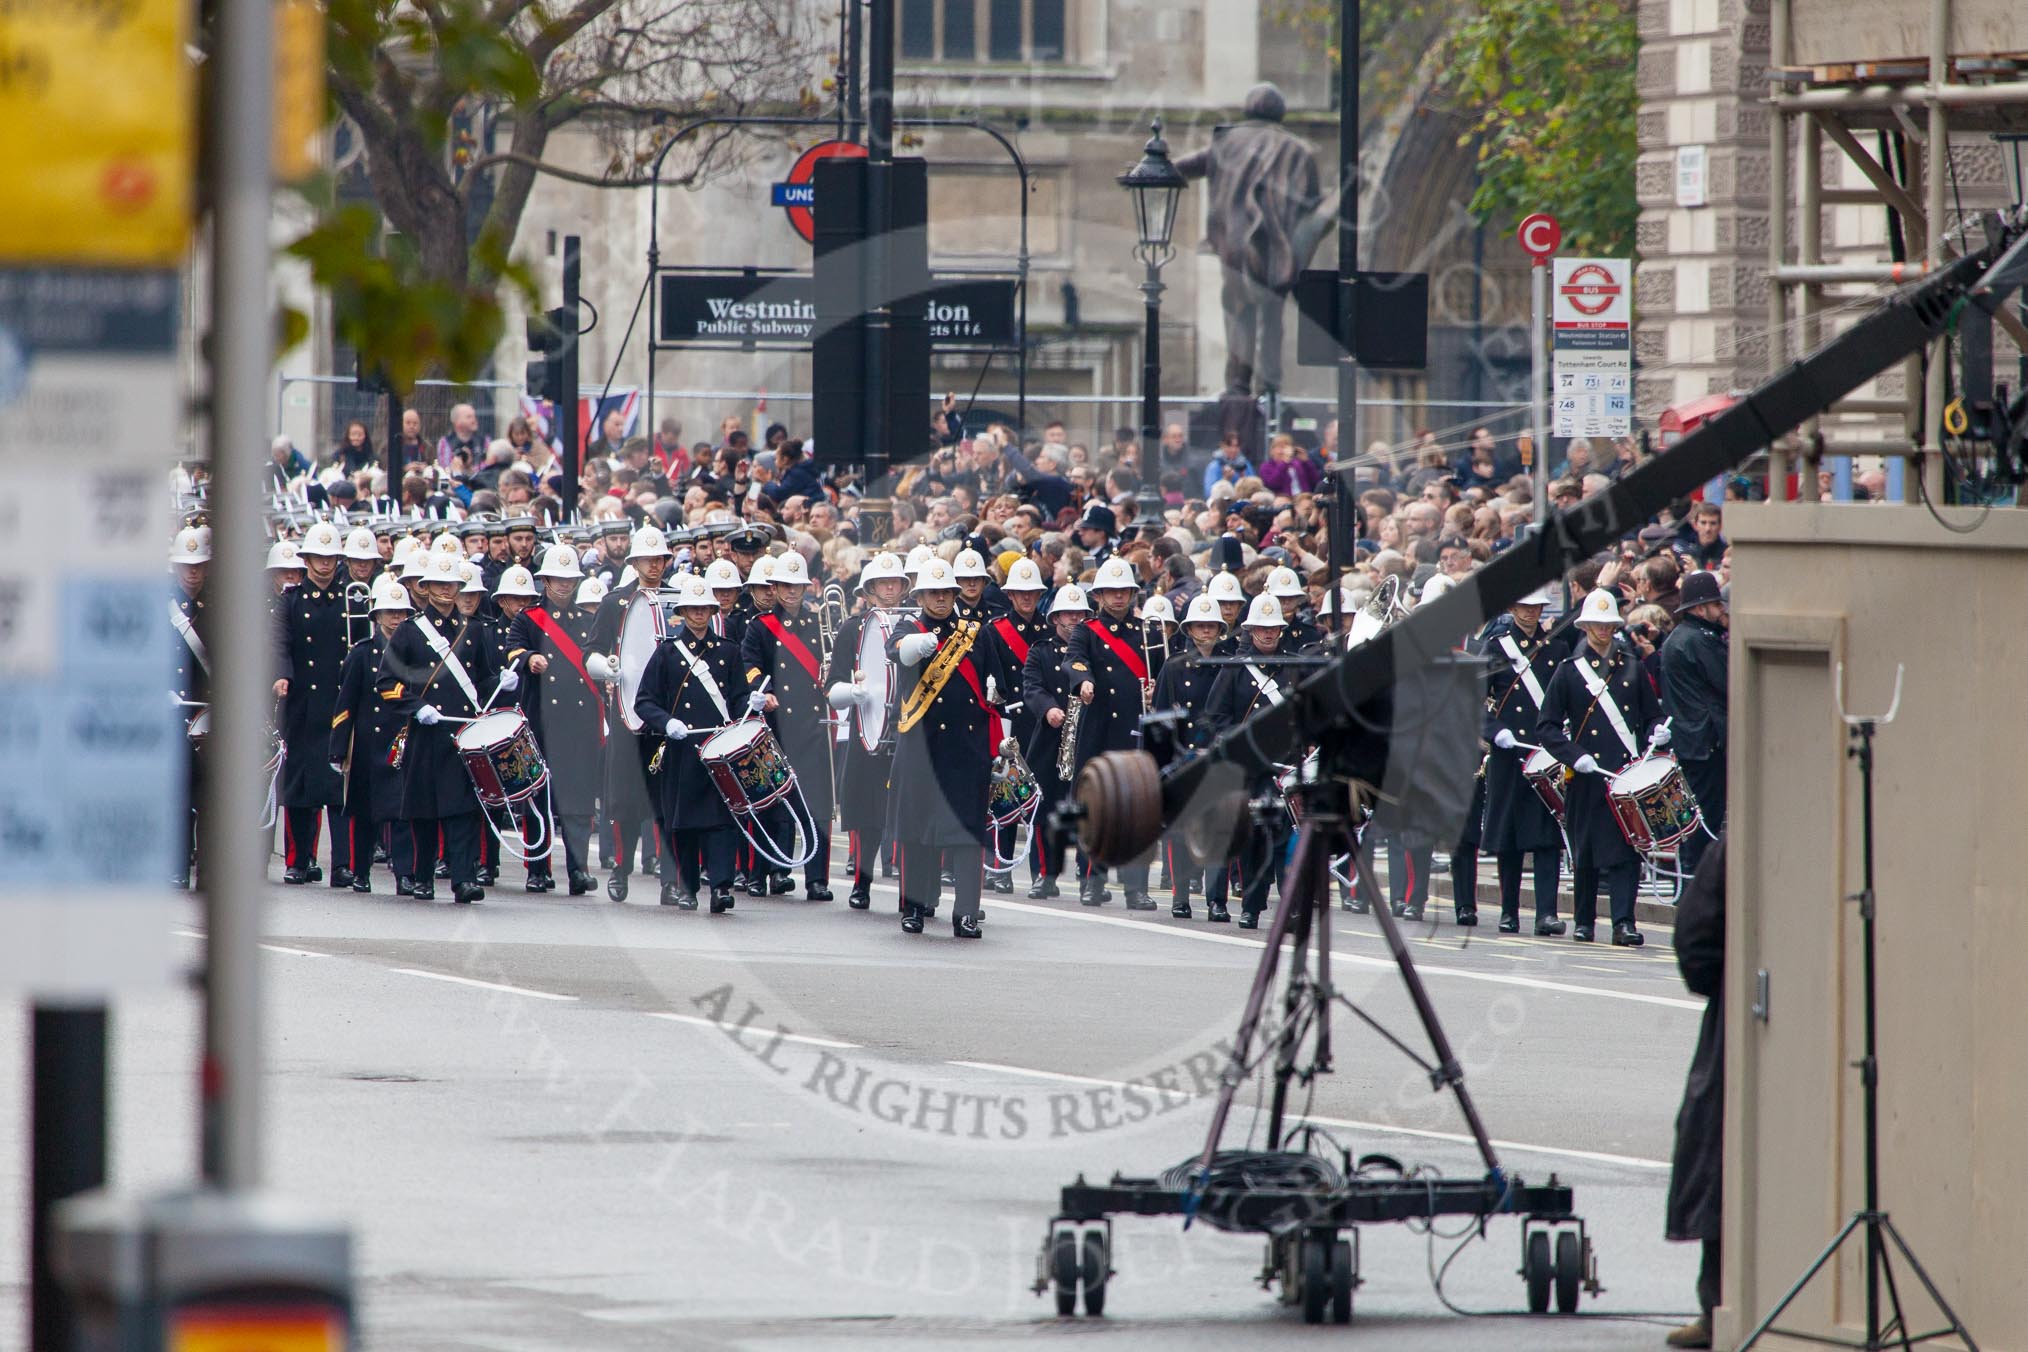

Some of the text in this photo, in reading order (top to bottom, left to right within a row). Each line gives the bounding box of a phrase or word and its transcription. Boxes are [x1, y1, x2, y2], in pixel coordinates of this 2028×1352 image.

[785, 188, 814, 201] UND
[1524, 220, 1551, 252] C
[1583, 286, 1599, 294] BUS
[706, 298, 817, 320] Westmin
[697, 320, 748, 333] Public
[752, 320, 813, 336] Subway
[1561, 379, 1573, 387] 24
[1559, 400, 1575, 409] 748
[1611, 400, 1625, 409] N2
